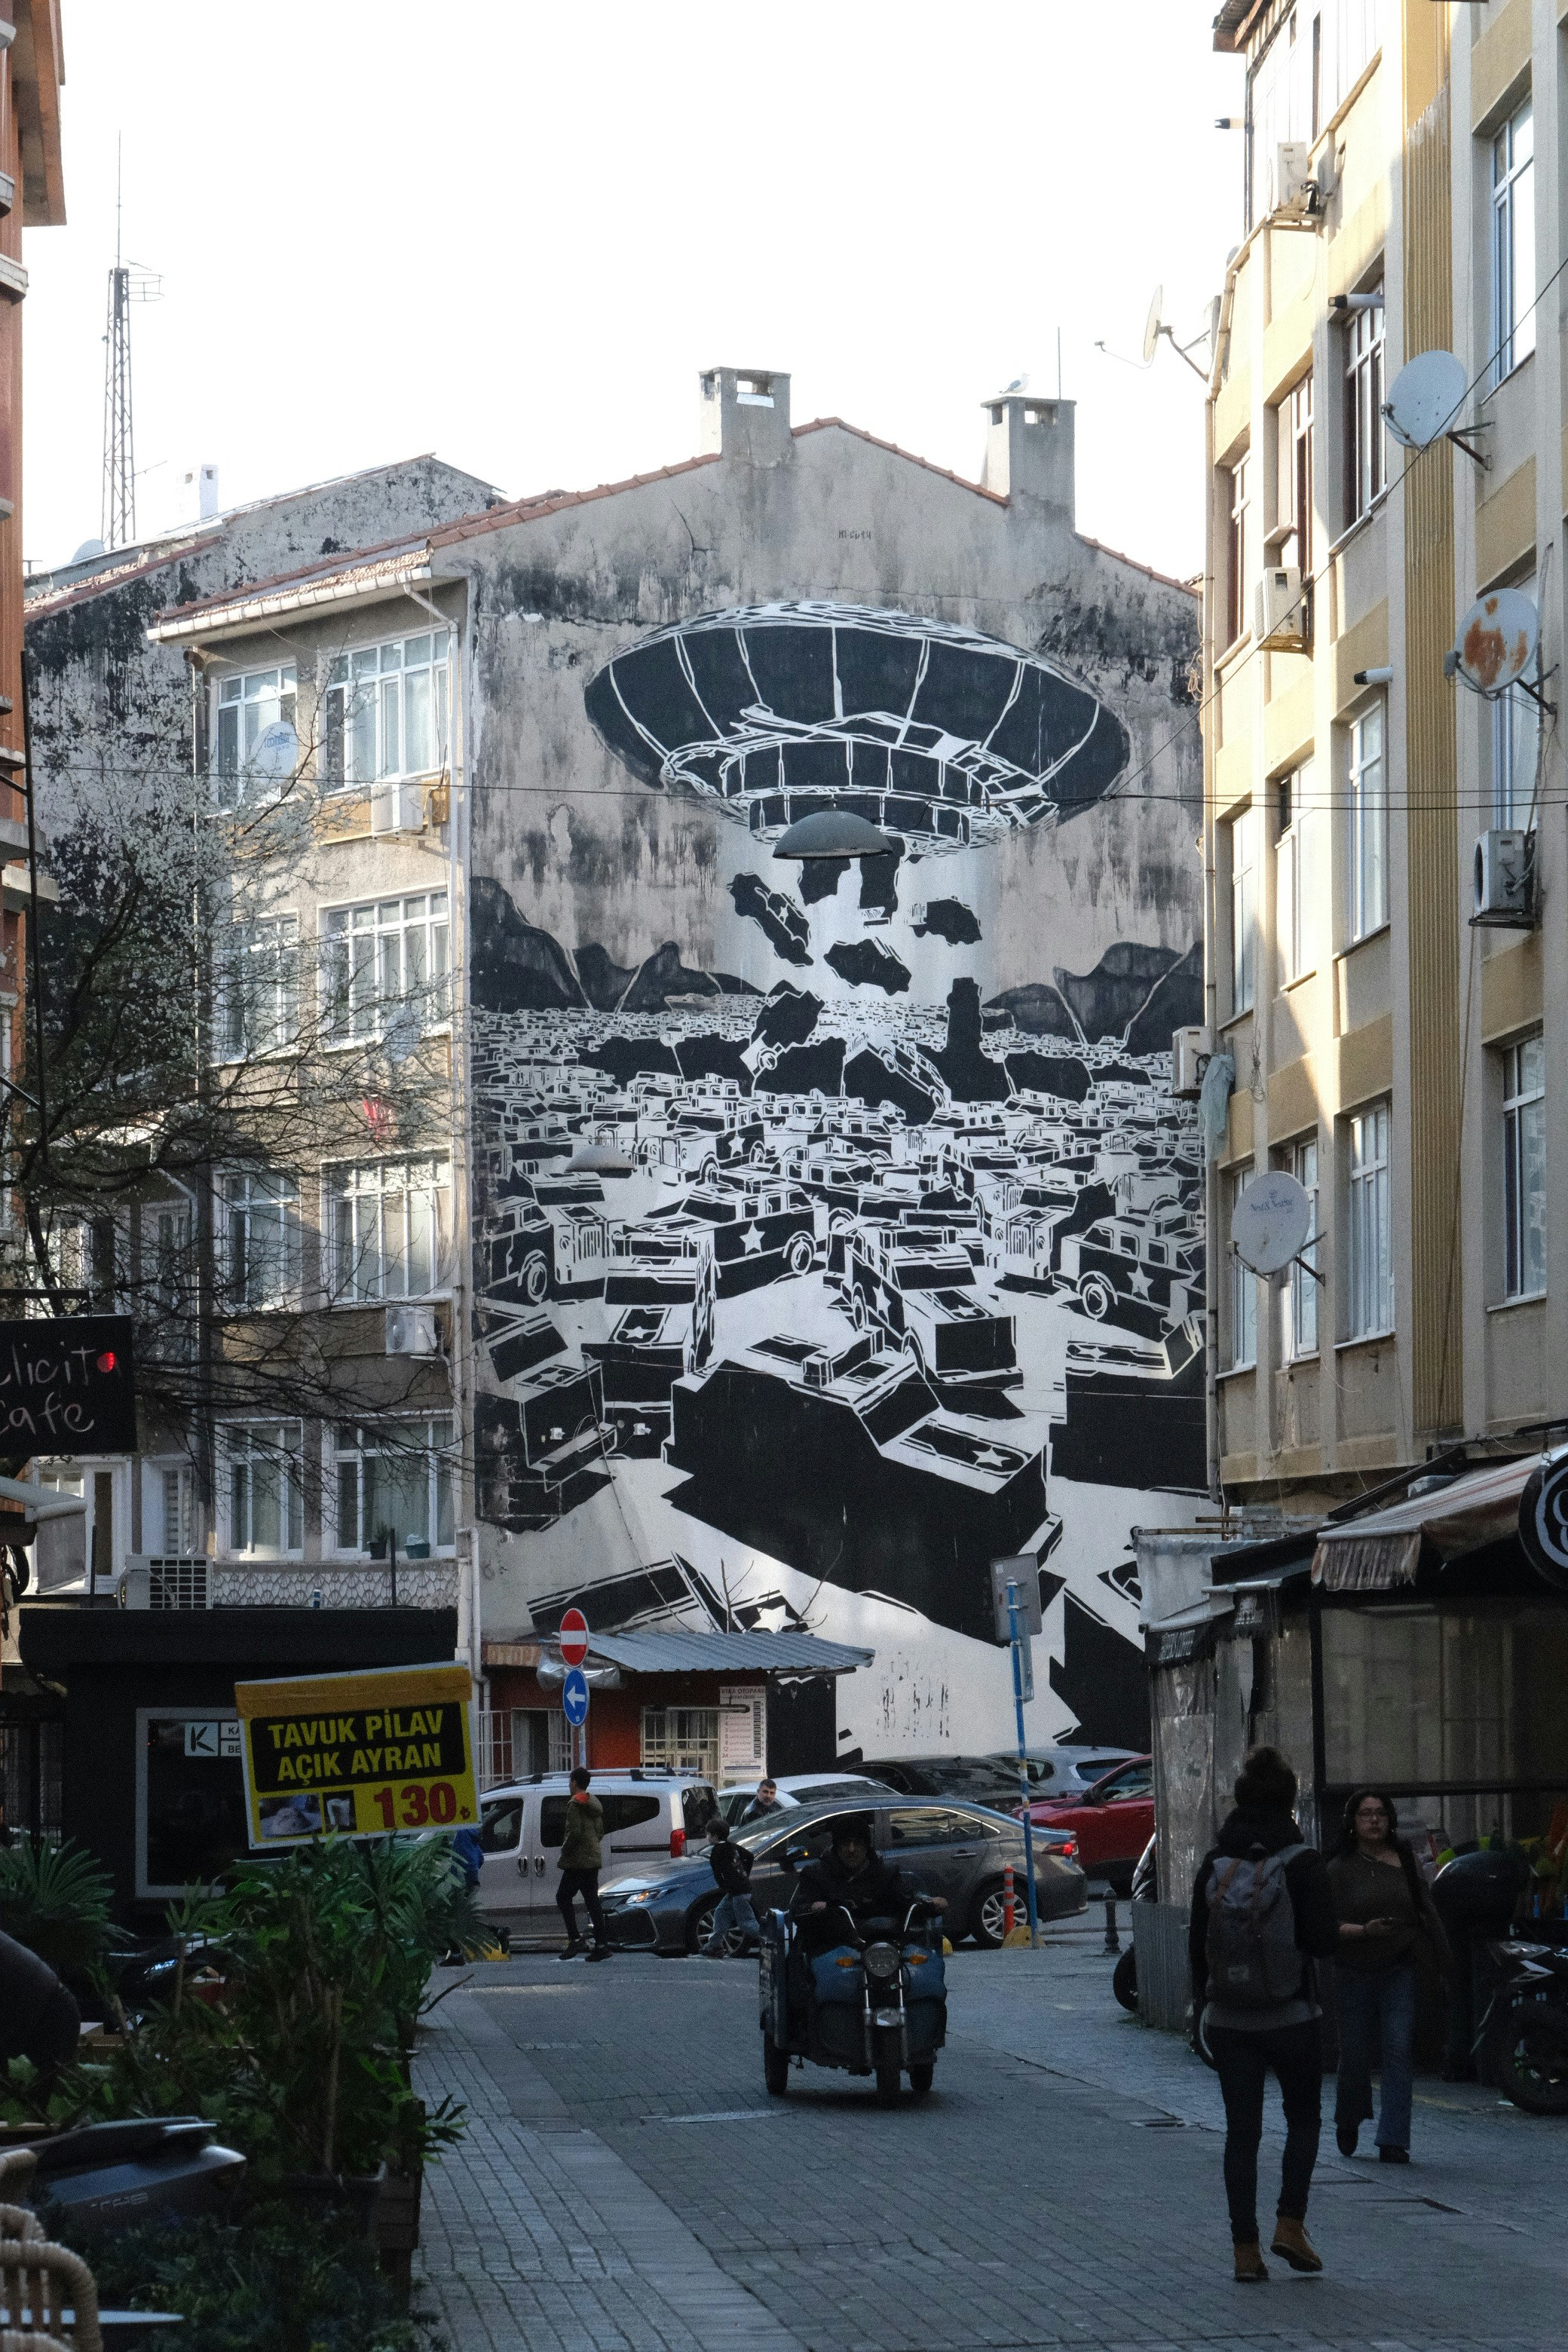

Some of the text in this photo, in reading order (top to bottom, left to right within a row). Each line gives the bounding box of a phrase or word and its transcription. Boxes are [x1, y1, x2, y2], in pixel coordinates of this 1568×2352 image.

[190, 1726, 216, 1753] K
[268, 1708, 443, 1749] TAVUK PİLAV
[277, 1742, 441, 1786] AÇIK AYRAN
